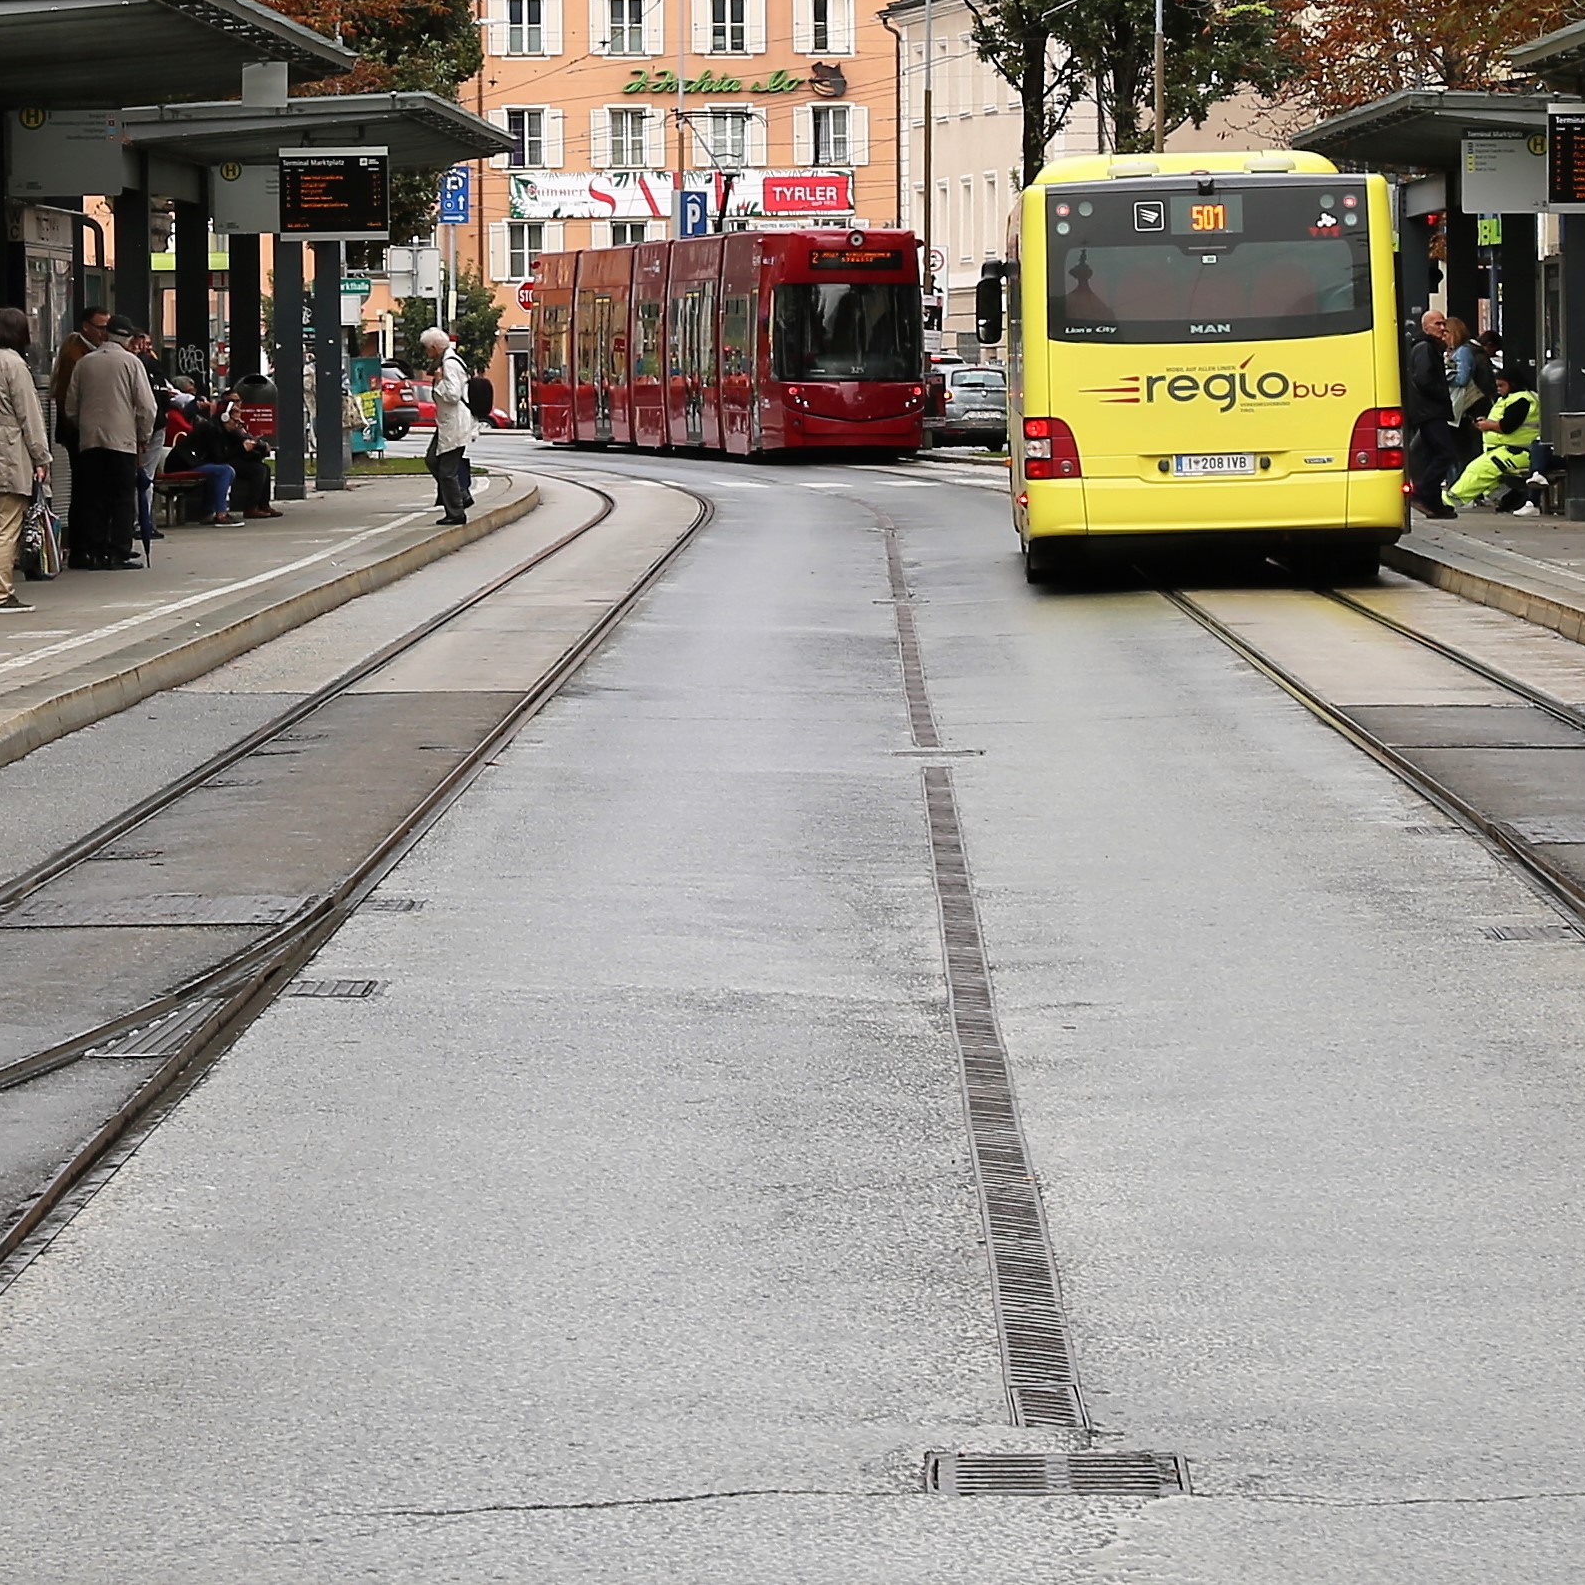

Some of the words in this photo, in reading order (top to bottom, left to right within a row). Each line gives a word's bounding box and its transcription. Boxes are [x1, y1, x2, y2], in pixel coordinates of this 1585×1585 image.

[282, 159, 310, 167] Terminal
[310, 159, 345, 167] Marktplatz
[527, 183, 586, 198] Summer
[772, 186, 838, 201] TYRLER
[687, 203, 702, 234] P
[1190, 204, 1226, 231] 501
[811, 252, 819, 265] 2
[1065, 326, 1093, 334] Lion's
[1095, 325, 1118, 334] City
[1189, 323, 1232, 334] MAN
[1201, 456, 1224, 470] 208
[1226, 456, 1247, 469] IVB
